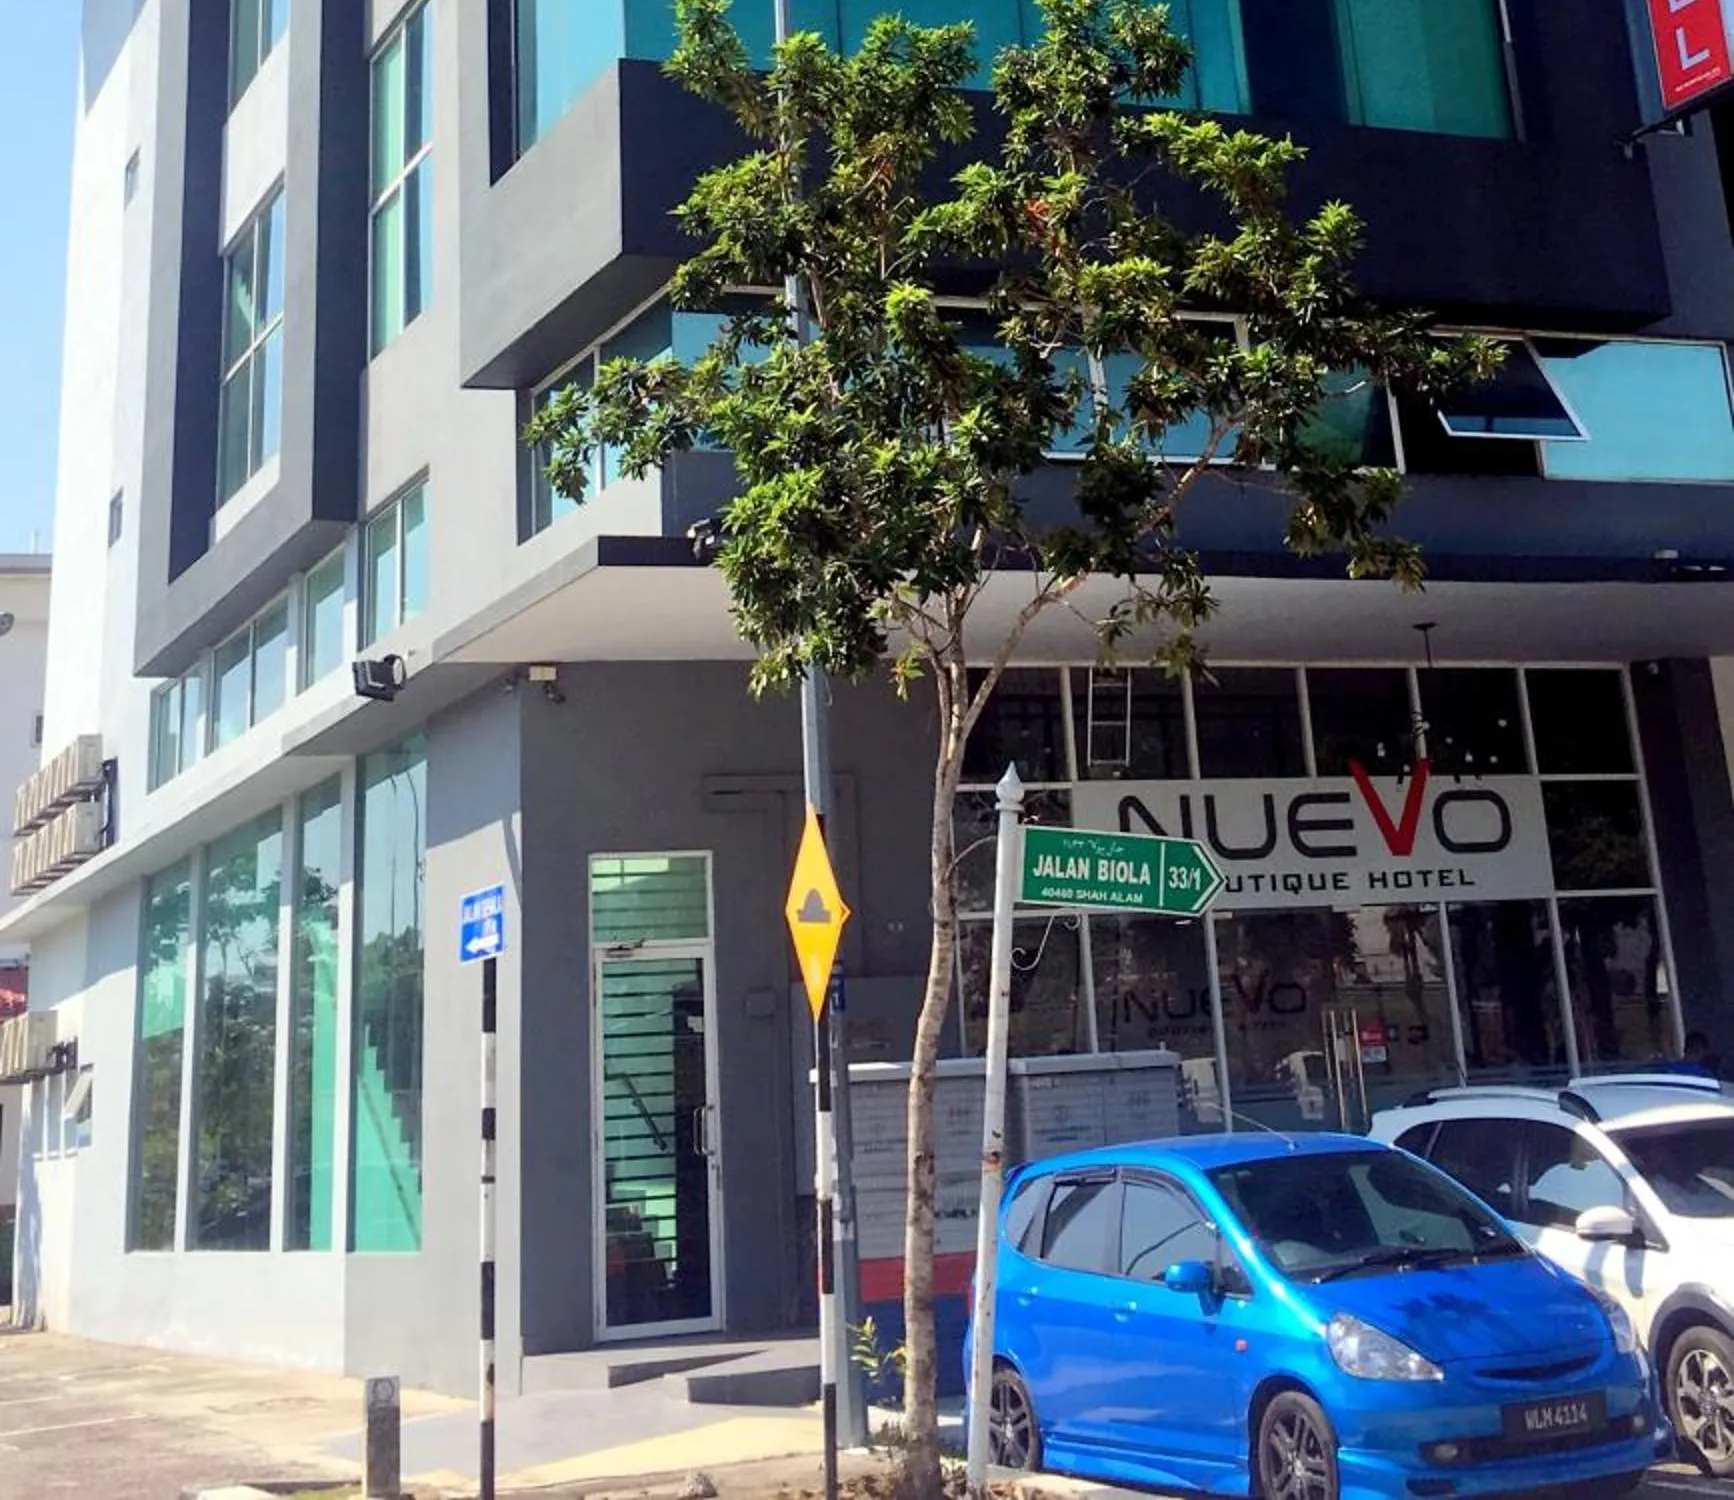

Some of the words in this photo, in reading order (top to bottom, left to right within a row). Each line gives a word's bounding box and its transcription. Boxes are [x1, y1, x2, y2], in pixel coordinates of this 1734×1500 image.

[1118, 757, 1512, 860] NUEVO
[1033, 854, 1090, 881] JALAN
[1097, 859, 1151, 886] BIOLA
[1168, 866, 1201, 891] 33/1
[1225, 872, 1349, 895] UTIQUE
[1369, 868, 1475, 890] HOTEL
[1076, 887, 1107, 902] SHAH
[1109, 890, 1143, 904] ALAM
